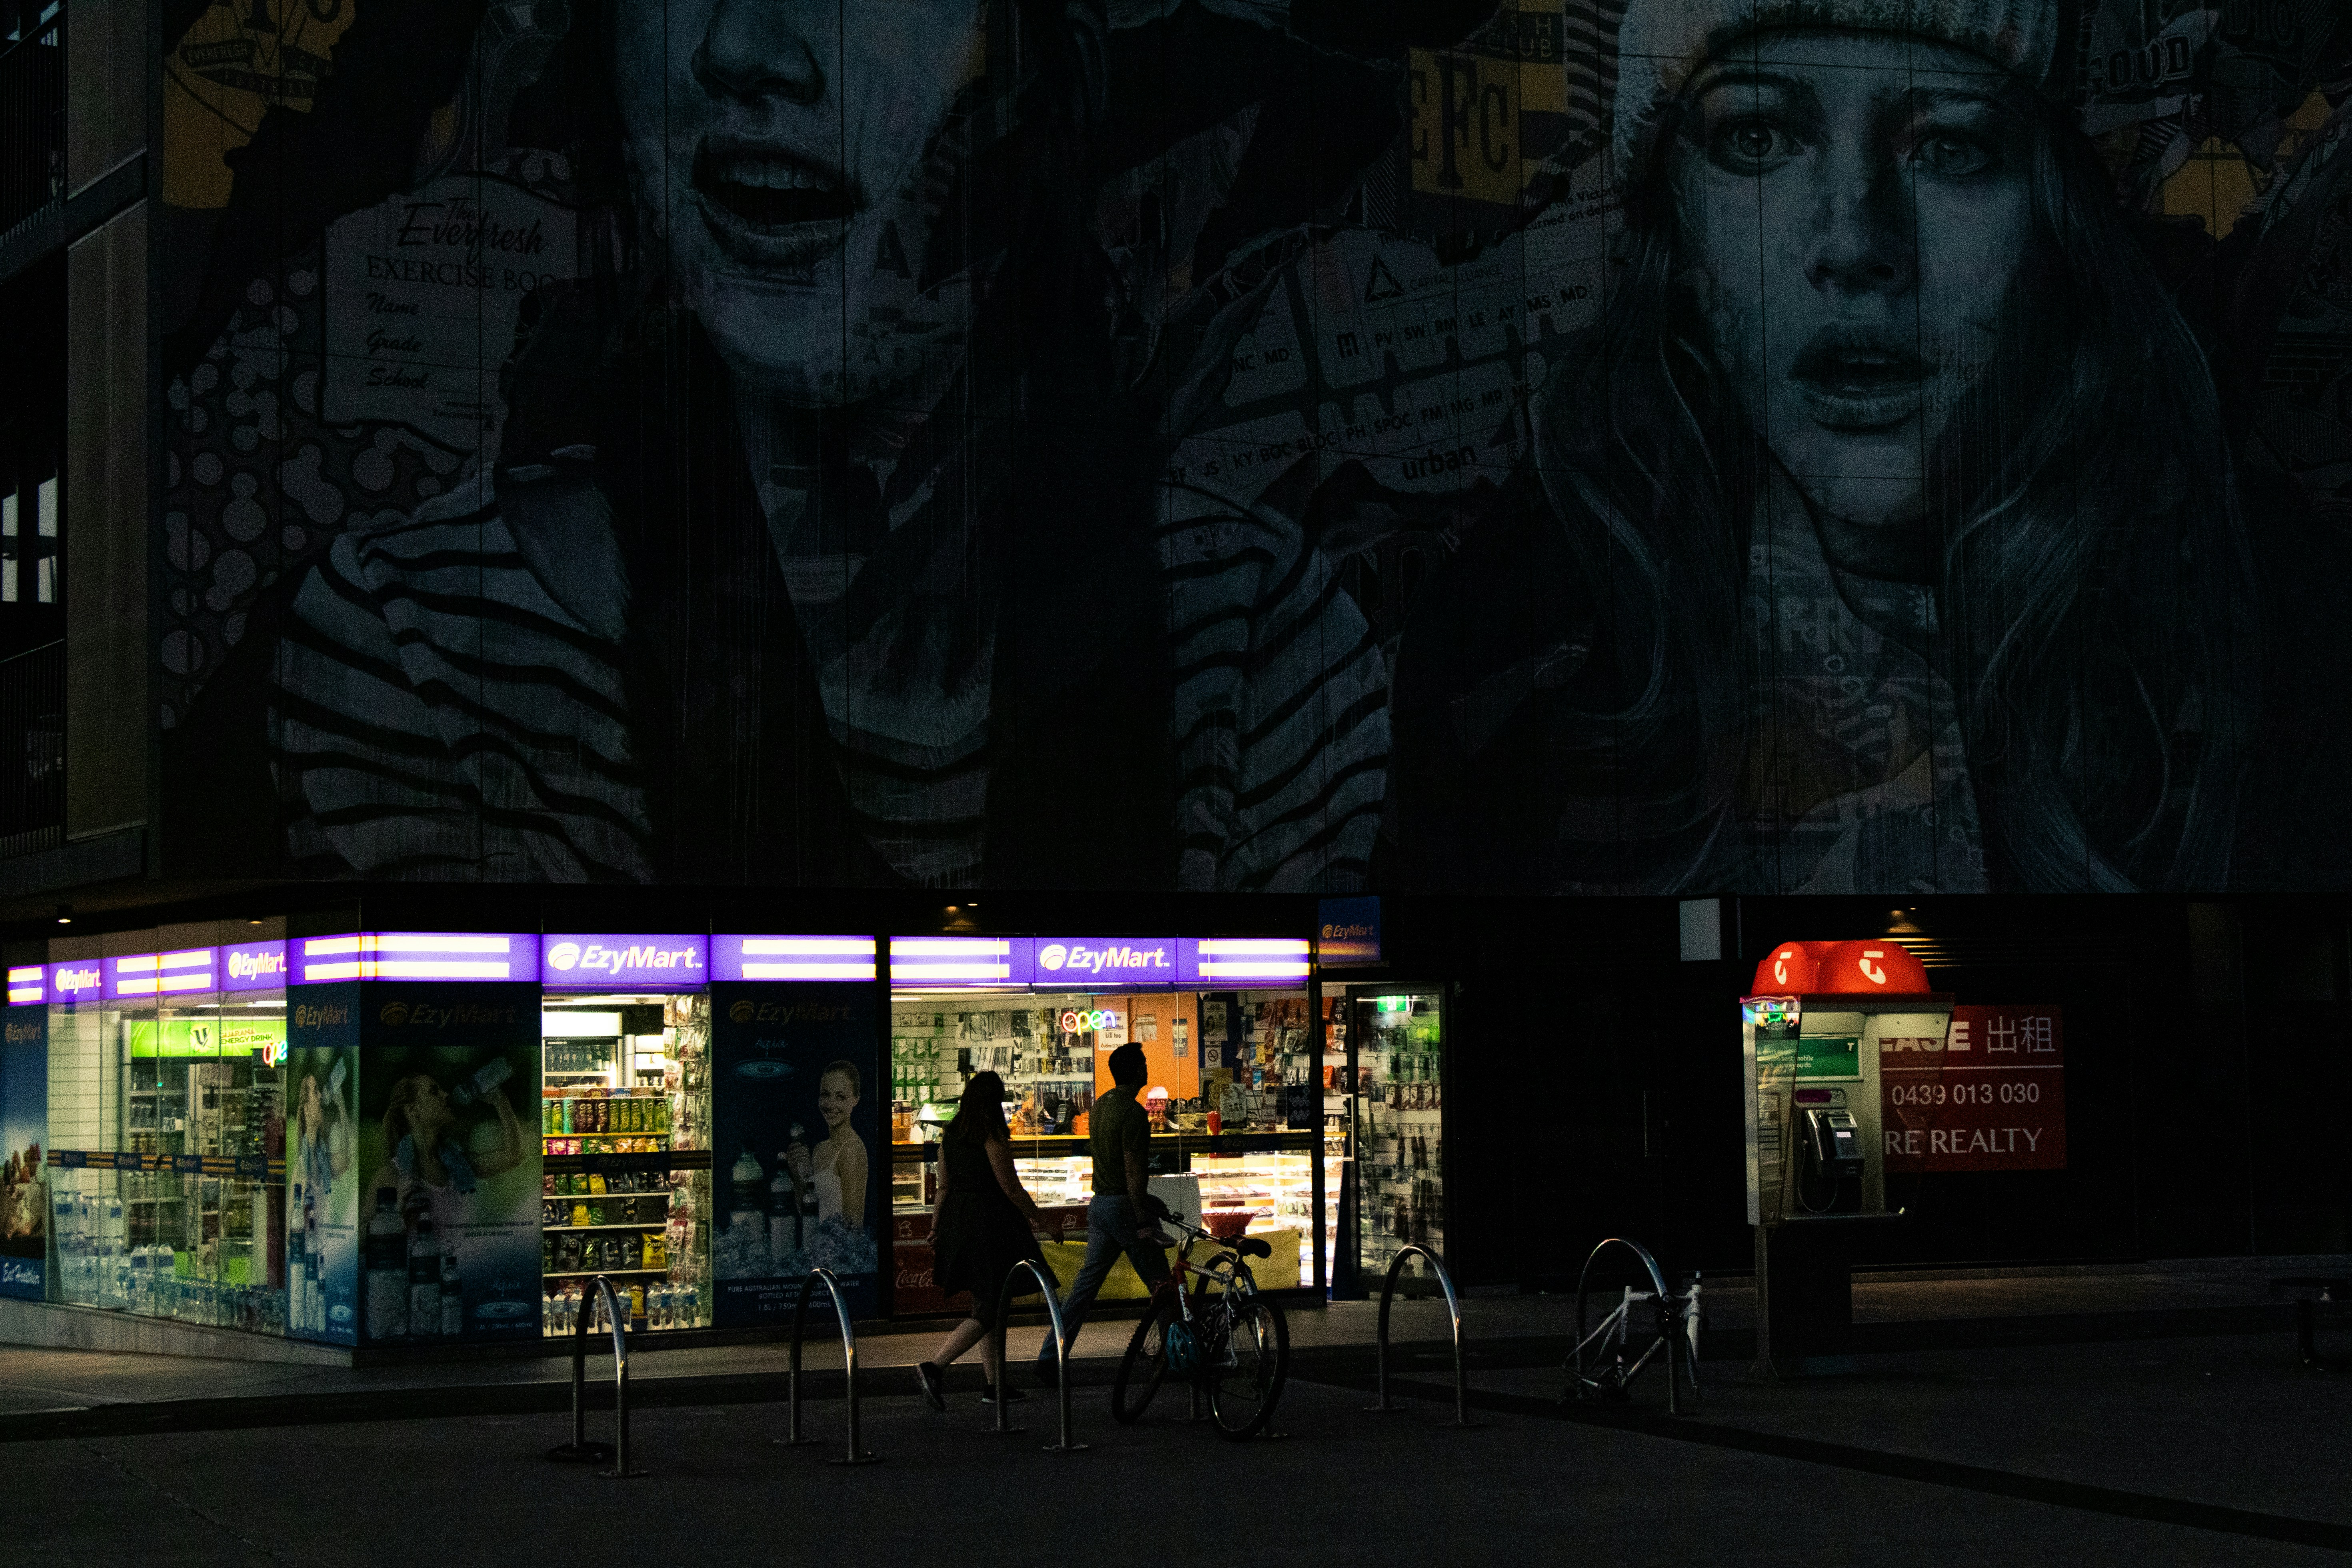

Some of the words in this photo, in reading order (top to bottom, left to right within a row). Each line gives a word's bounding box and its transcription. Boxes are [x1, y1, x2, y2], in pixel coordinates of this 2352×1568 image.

[448, 198, 476, 220] The
[398, 203, 545, 265] Everfresh
[366, 255, 496, 289] EXERCISE
[366, 292, 420, 316] Name
[1404, 324, 1425, 340] SW
[1499, 305, 1515, 321] AY
[1526, 295, 1551, 312] MS
[1560, 285, 1588, 303] MD
[366, 329, 422, 355] Grade
[1264, 348, 1290, 364] MD
[366, 368, 429, 389] School
[1232, 451, 1253, 468] KY
[1346, 426, 1367, 441] PH
[1374, 413, 1413, 434] SPOC
[1421, 404, 1443, 421] FM
[1450, 398, 1475, 415] MG
[1481, 390, 1503, 406] MR
[1402, 445, 1478, 480] urban
[1333, 924, 1374, 940] EzyMart
[240, 951, 285, 981] EzyMart
[580, 945, 696, 974] EzyMart
[1066, 947, 1165, 973] EzyMart
[65, 968, 101, 995] EzyMart
[306, 1004, 349, 1031] EzyMart
[410, 1003, 517, 1028] EzyMart
[755, 1001, 851, 1026] EzyMart
[1061, 1009, 1117, 1036] open
[221, 1035, 250, 1045] ENERGY
[251, 1033, 273, 1042] DRINK
[1987, 1016, 2056, 1054] 出租
[1892, 1084, 1946, 1106] 0439
[1953, 1083, 1993, 1104] 013
[2000, 1083, 2040, 1104] 030
[1930, 1128, 2042, 1154] REALTY
